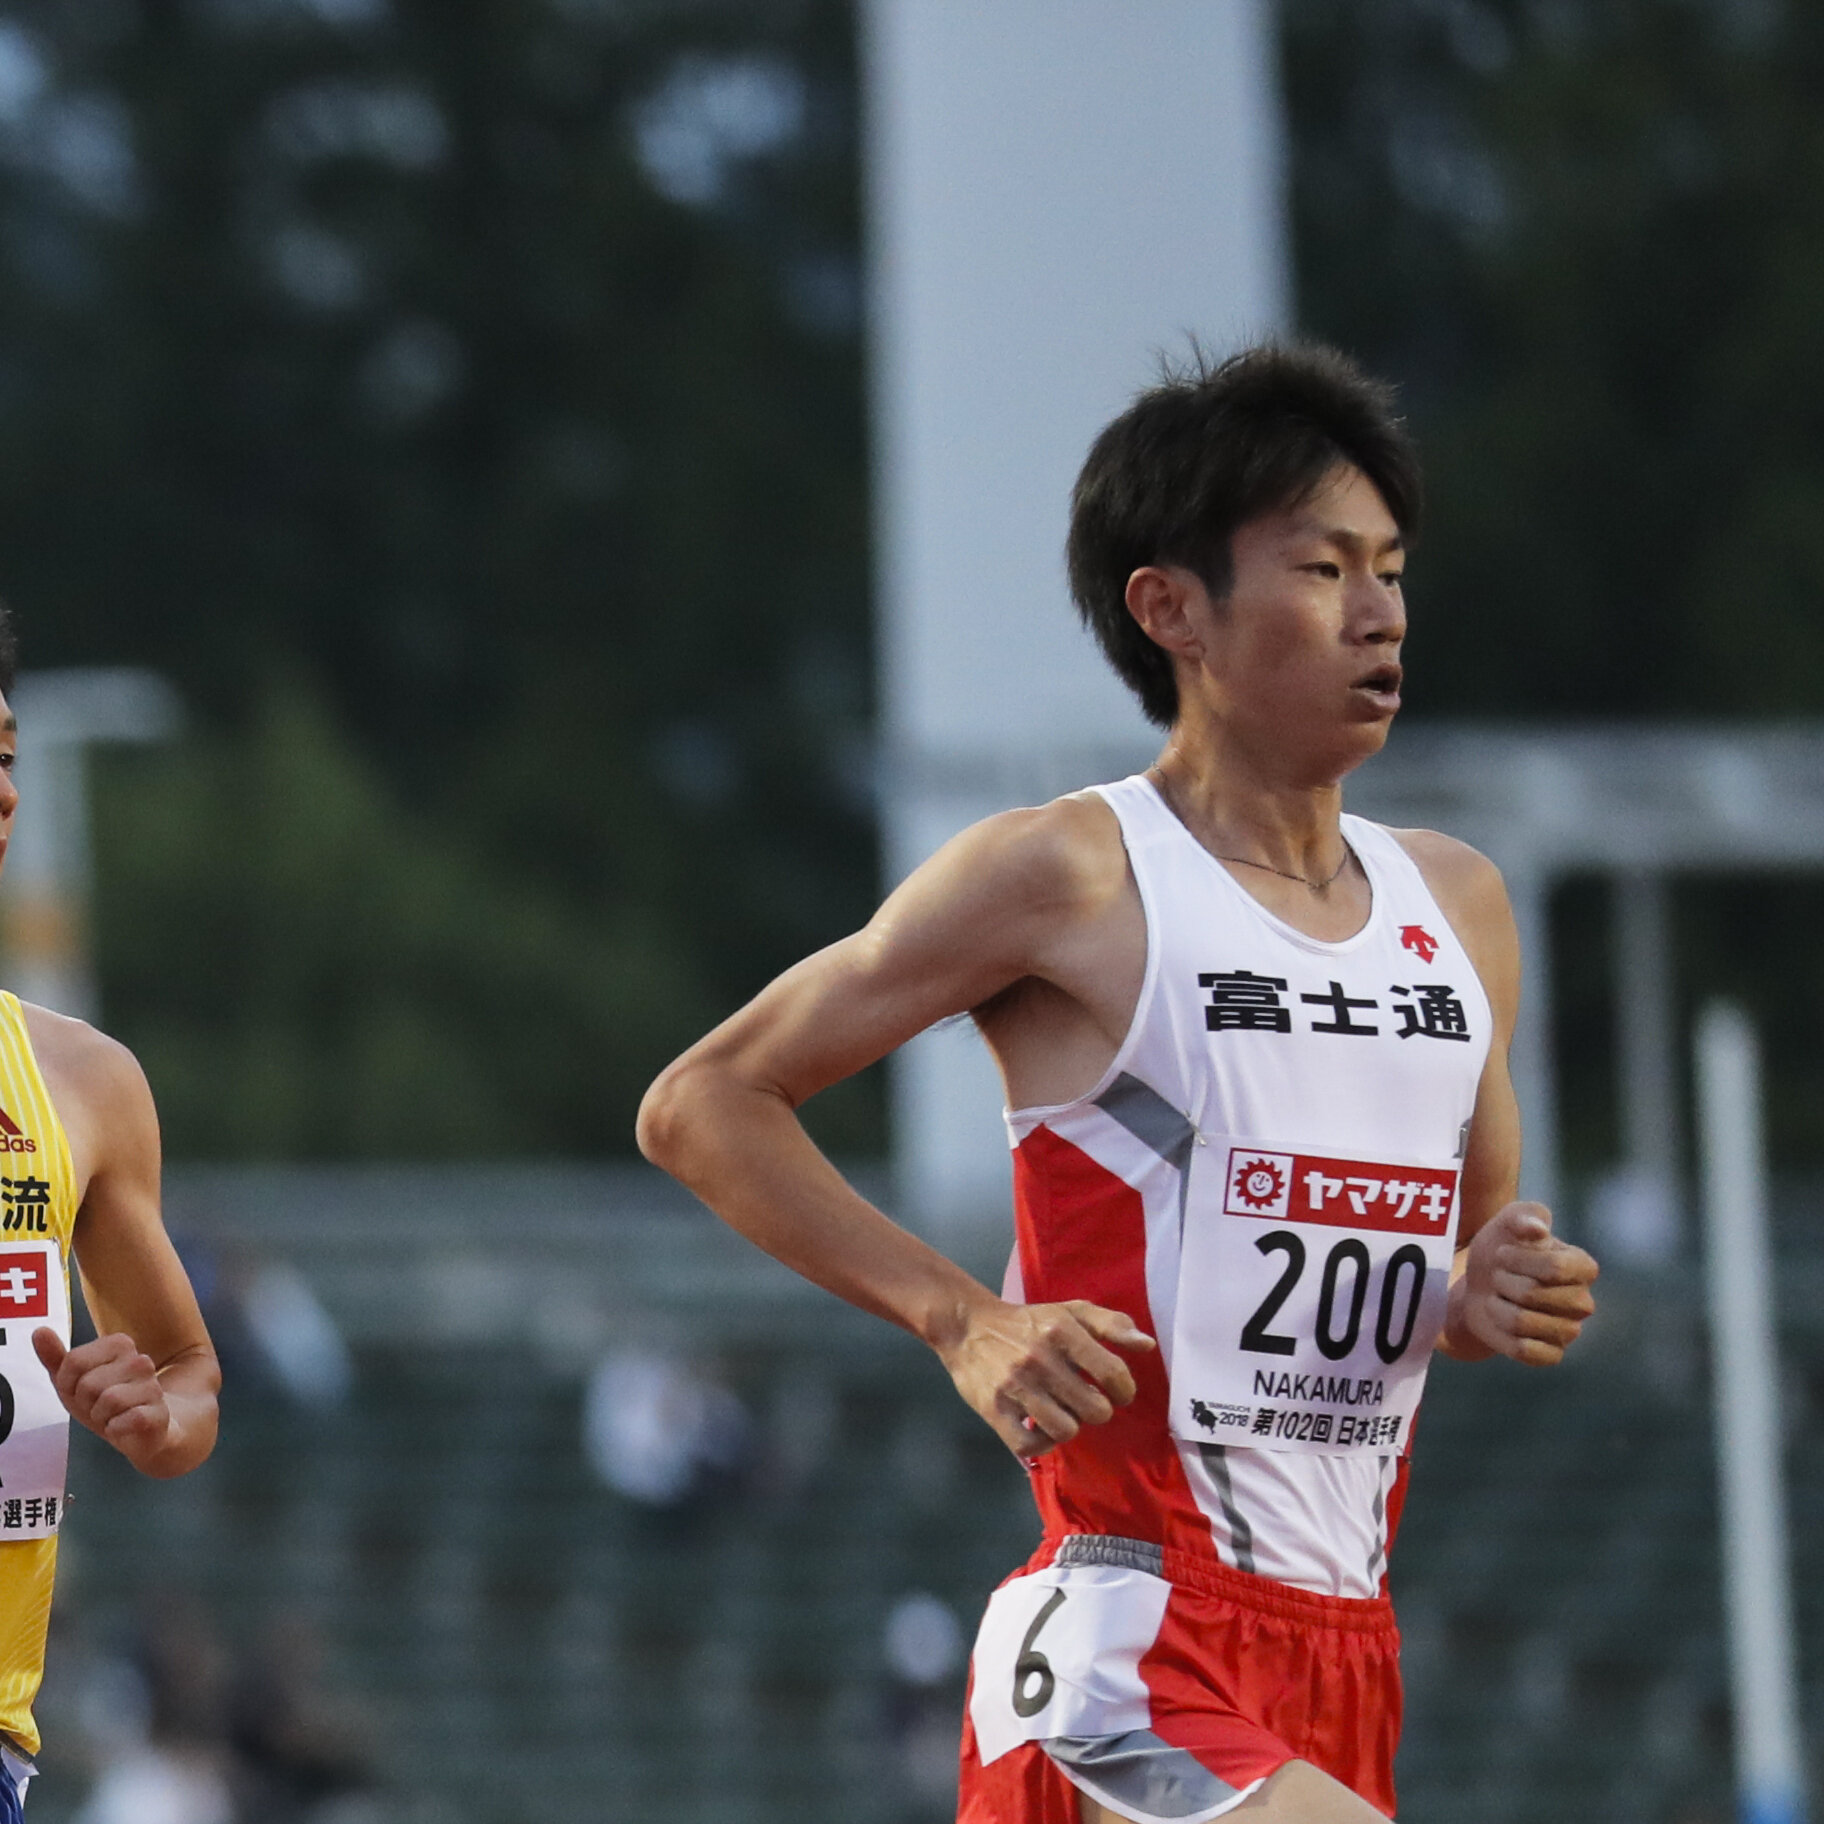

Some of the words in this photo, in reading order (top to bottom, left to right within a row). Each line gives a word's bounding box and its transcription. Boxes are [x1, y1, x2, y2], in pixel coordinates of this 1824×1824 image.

[1197, 970, 1471, 1043] 富士通
[1303, 1171, 1450, 1222] ヤマザキ
[1239, 1230, 1426, 1365] 200
[1253, 1369, 1384, 1406] NAKAMURA
[1219, 1411, 1249, 1428] 2018
[1012, 1587, 1067, 1718] 6
